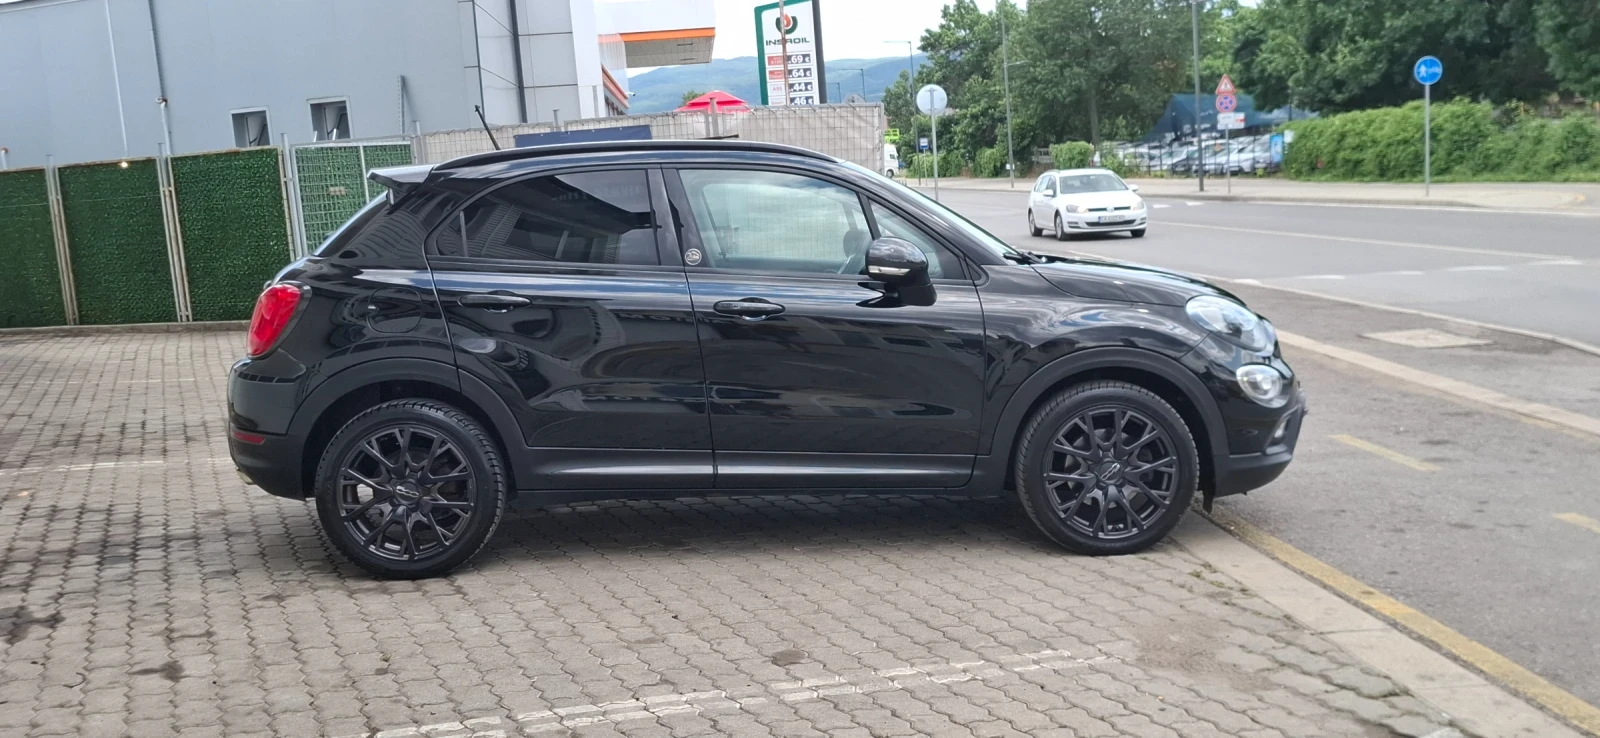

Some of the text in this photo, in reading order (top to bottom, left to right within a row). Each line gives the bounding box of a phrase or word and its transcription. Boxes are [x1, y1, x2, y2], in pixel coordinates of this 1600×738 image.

[787, 55, 803, 64] .69
[788, 69, 804, 78] .64
[789, 83, 805, 91] .44
